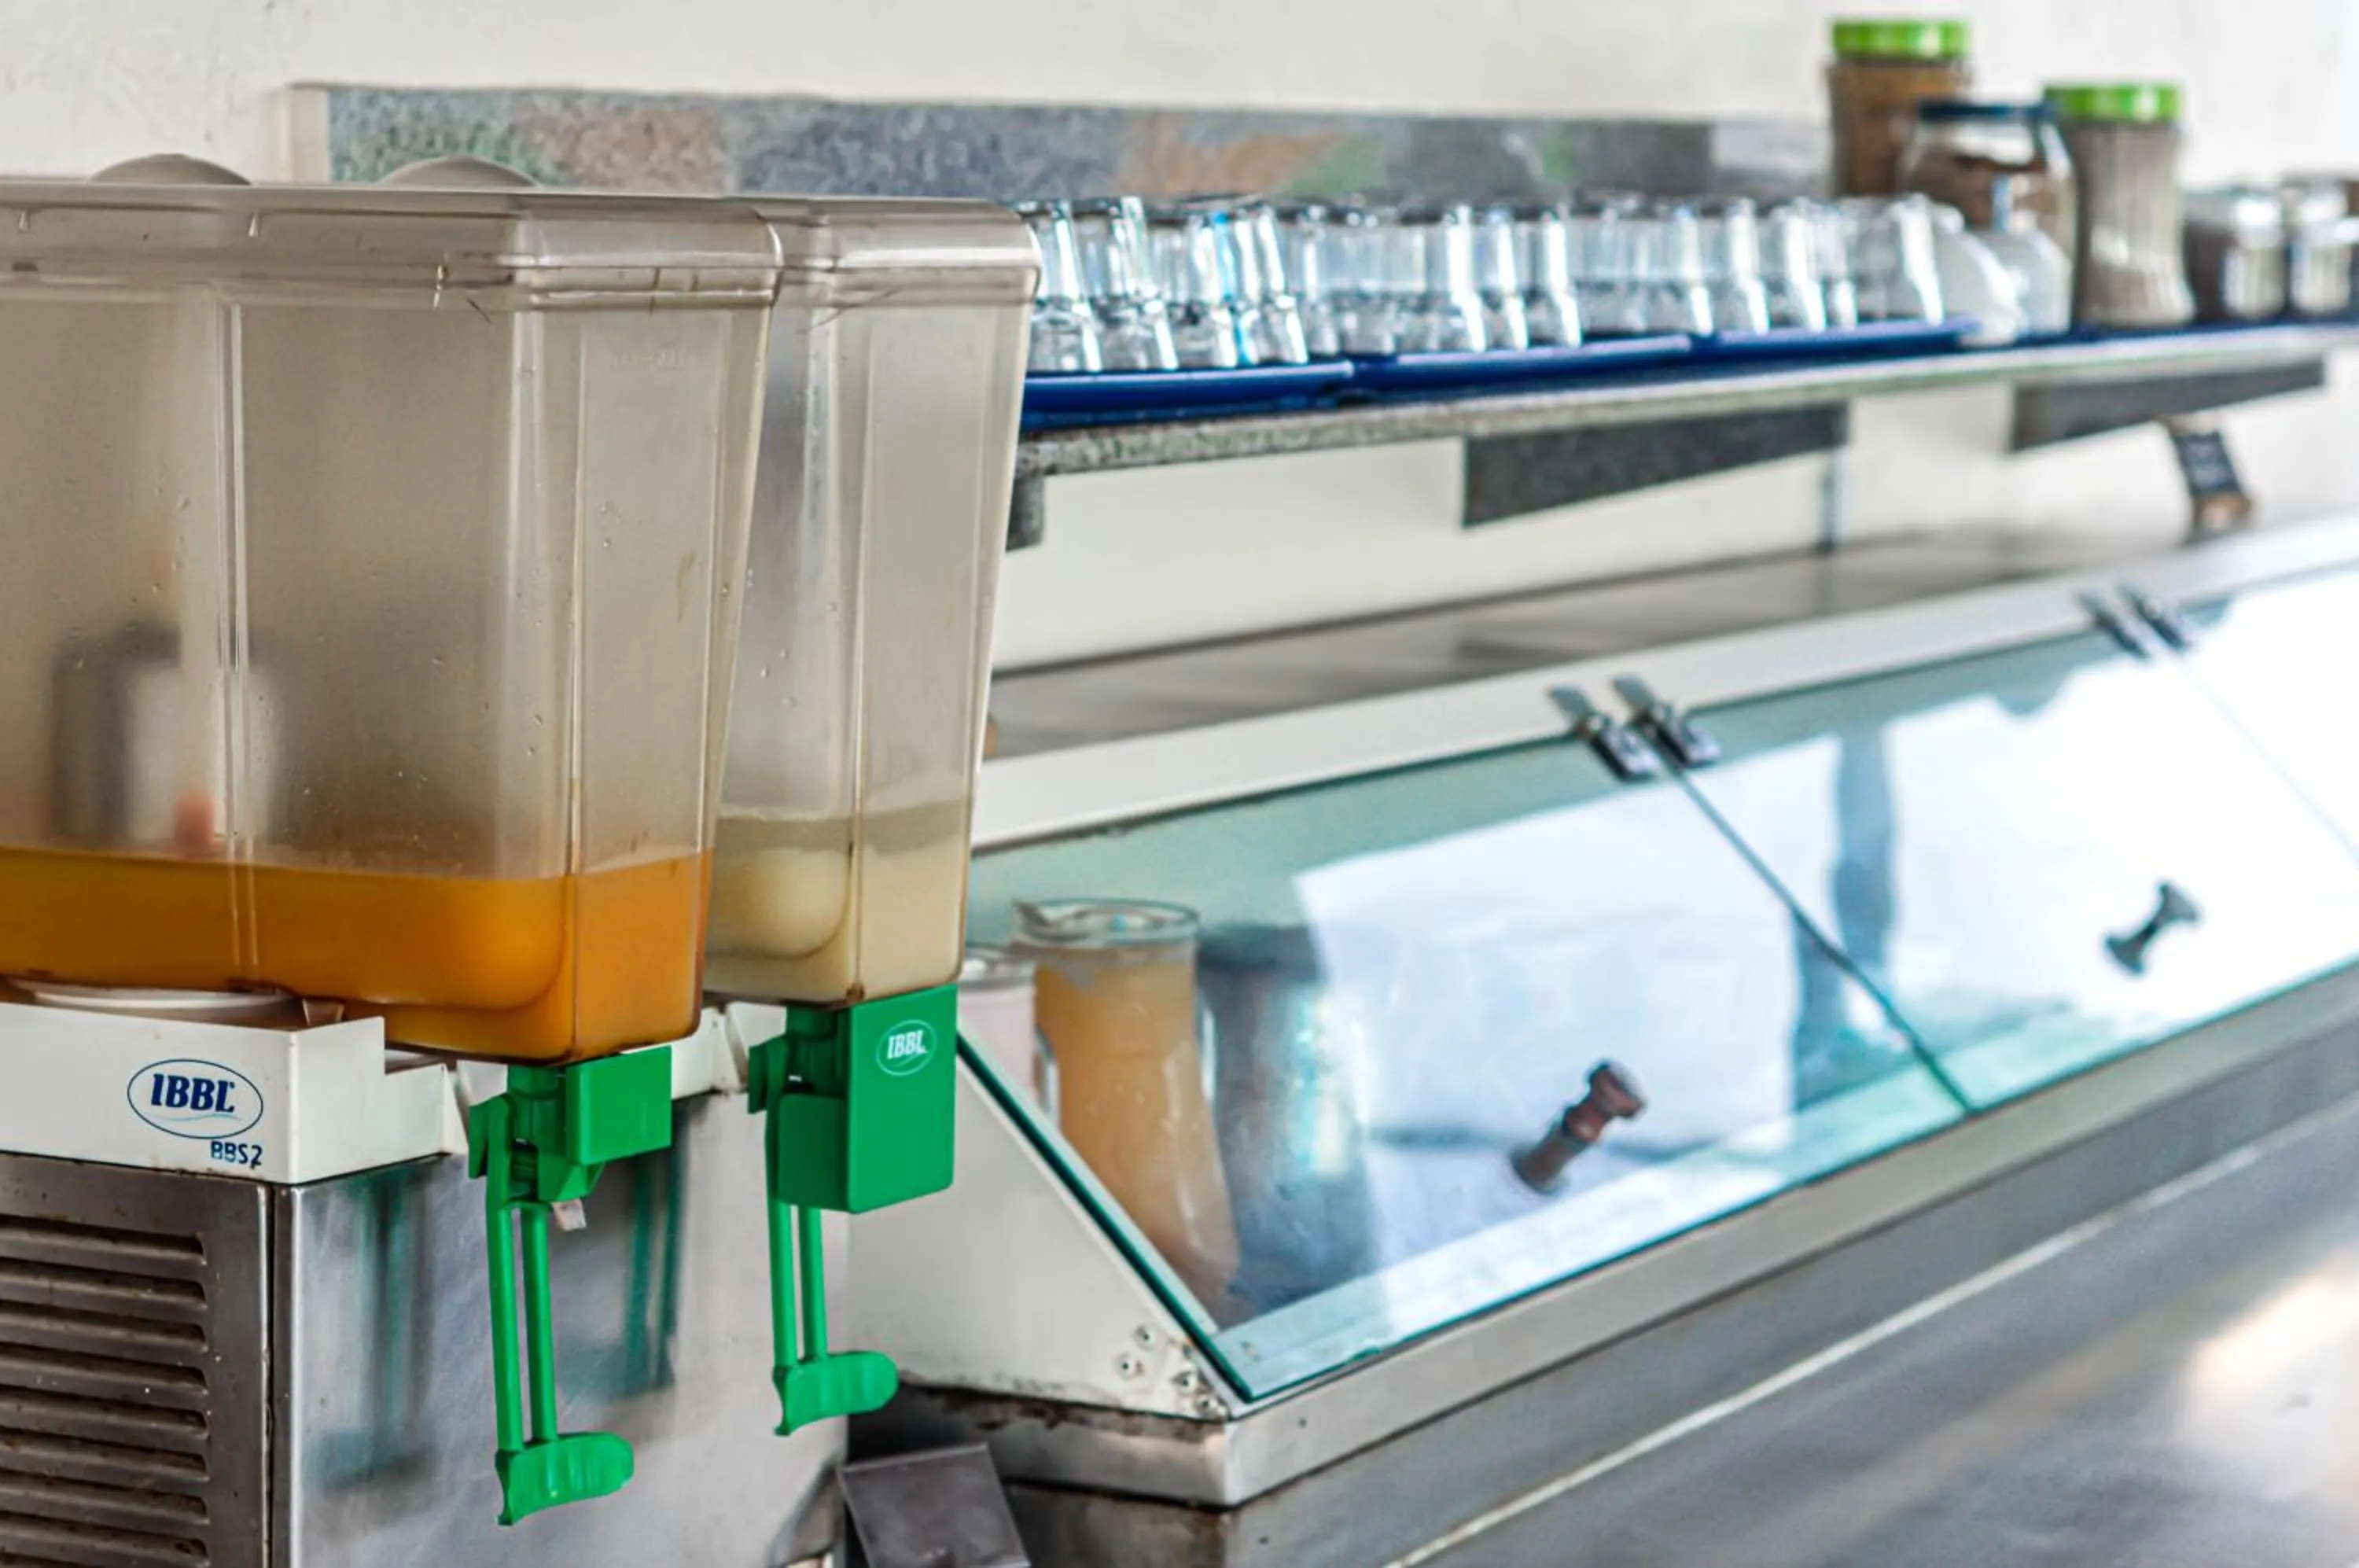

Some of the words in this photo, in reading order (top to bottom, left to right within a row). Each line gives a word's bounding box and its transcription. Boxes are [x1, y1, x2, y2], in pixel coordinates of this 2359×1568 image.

[887, 1029, 926, 1059] IBBL
[151, 1073, 235, 1113] IBBL
[210, 1140, 263, 1169] BBS2
